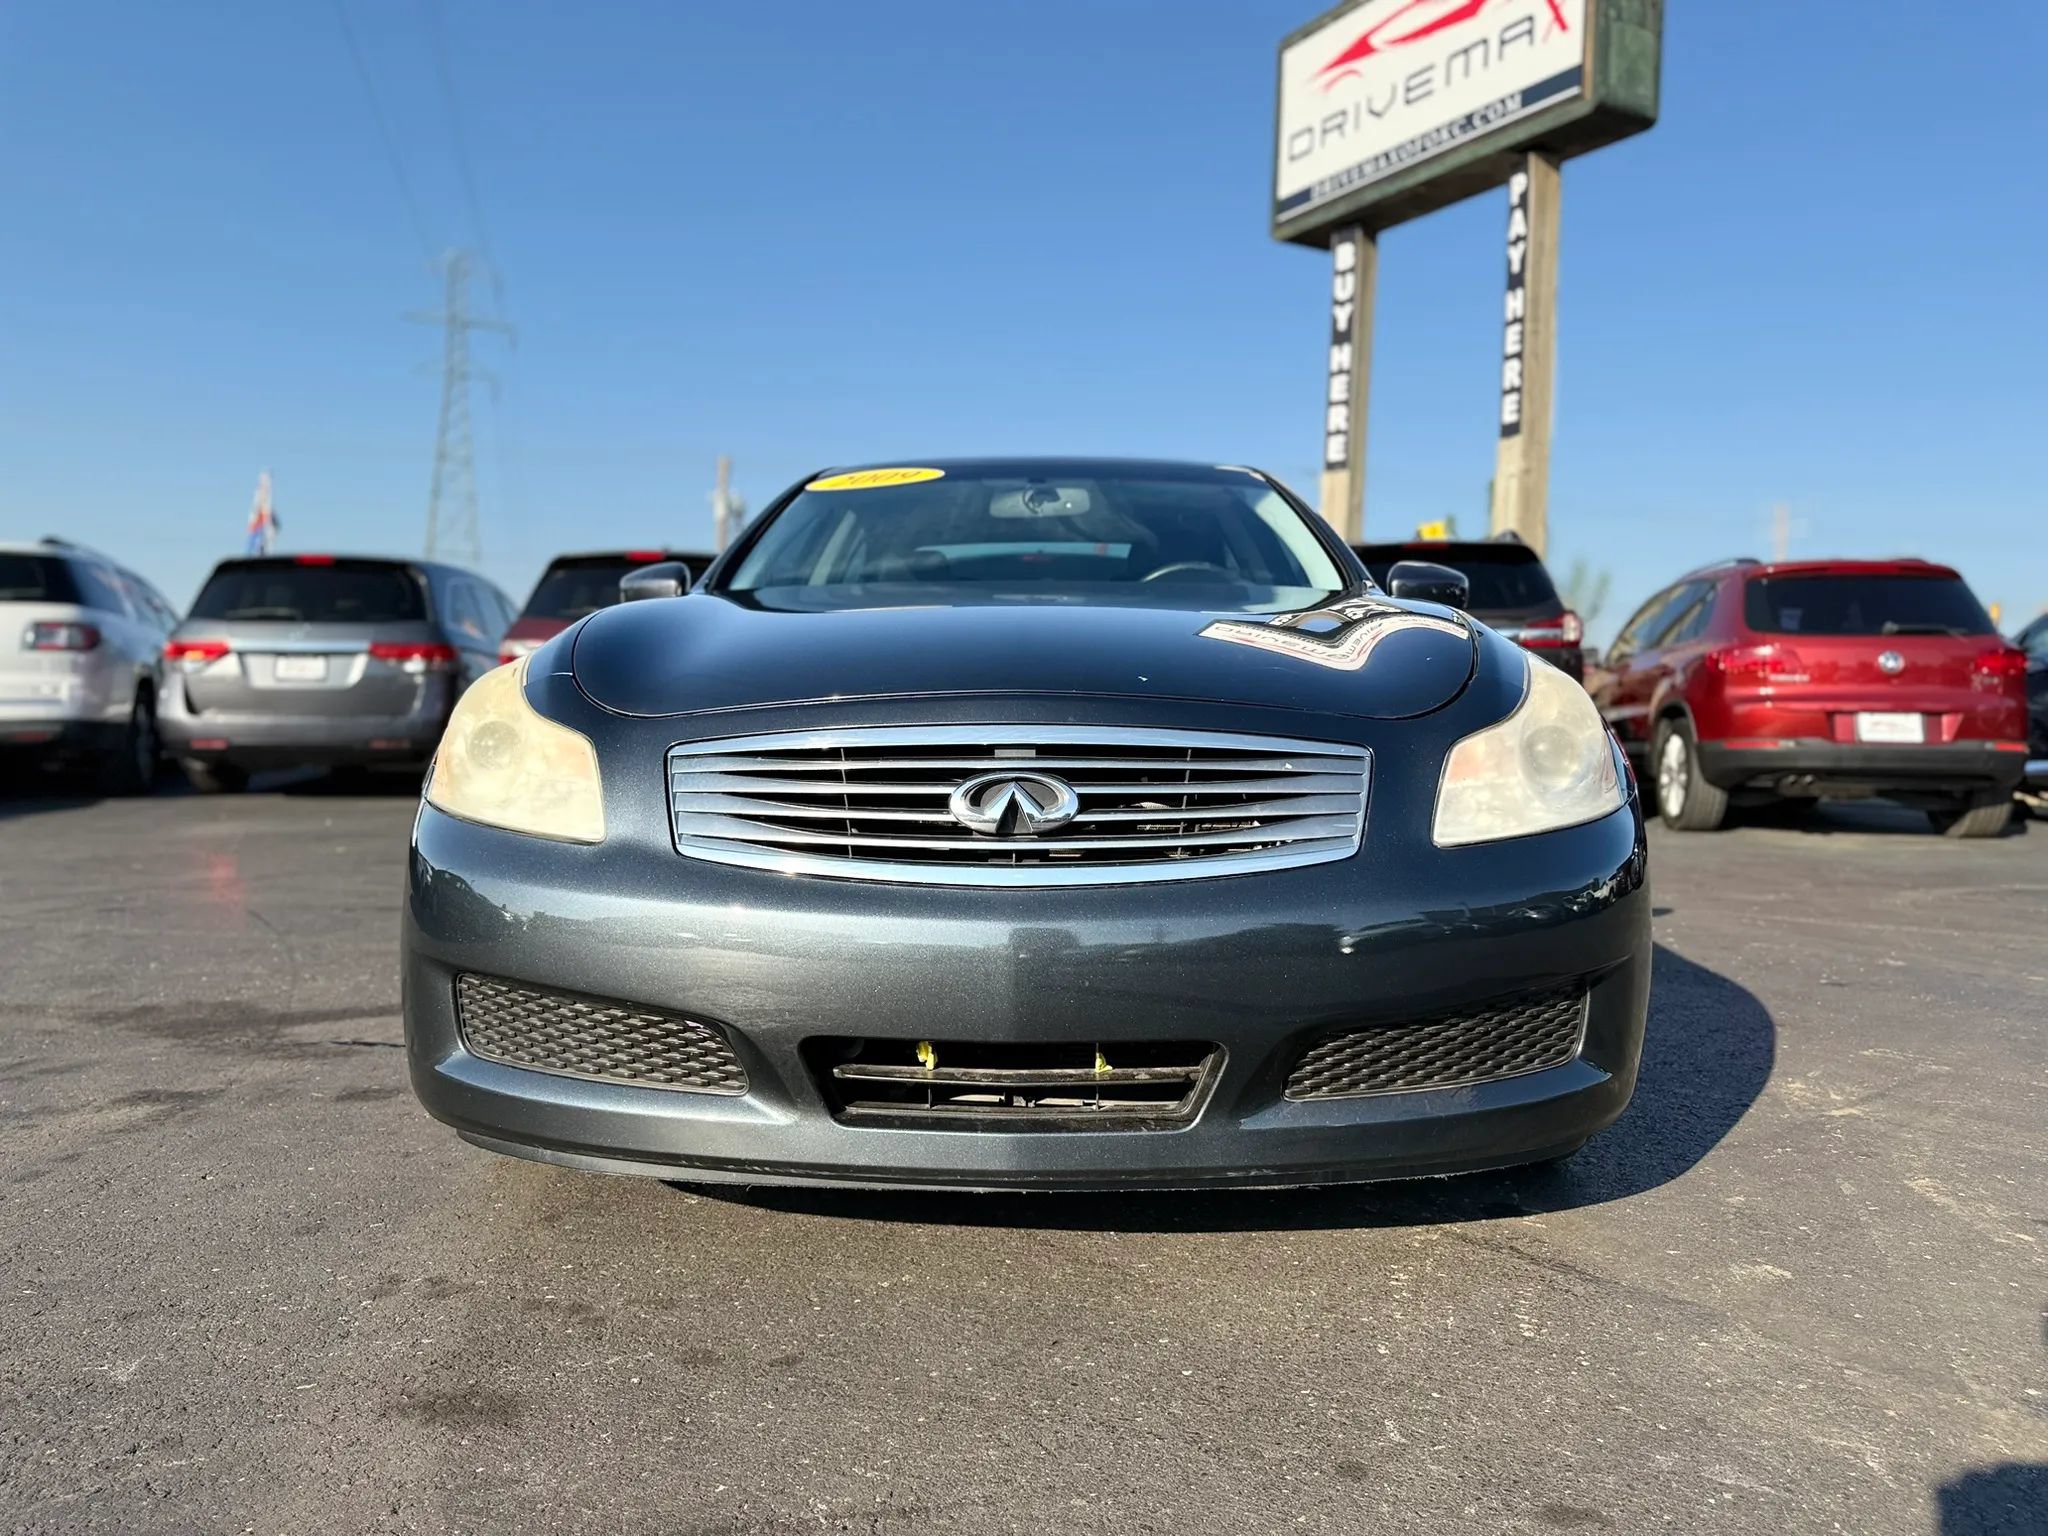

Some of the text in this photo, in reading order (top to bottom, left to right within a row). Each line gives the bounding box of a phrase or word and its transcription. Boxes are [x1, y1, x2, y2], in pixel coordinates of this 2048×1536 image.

[1326, 240, 1355, 464] BUY HERE
[1502, 171, 1528, 425] PAY HERE
